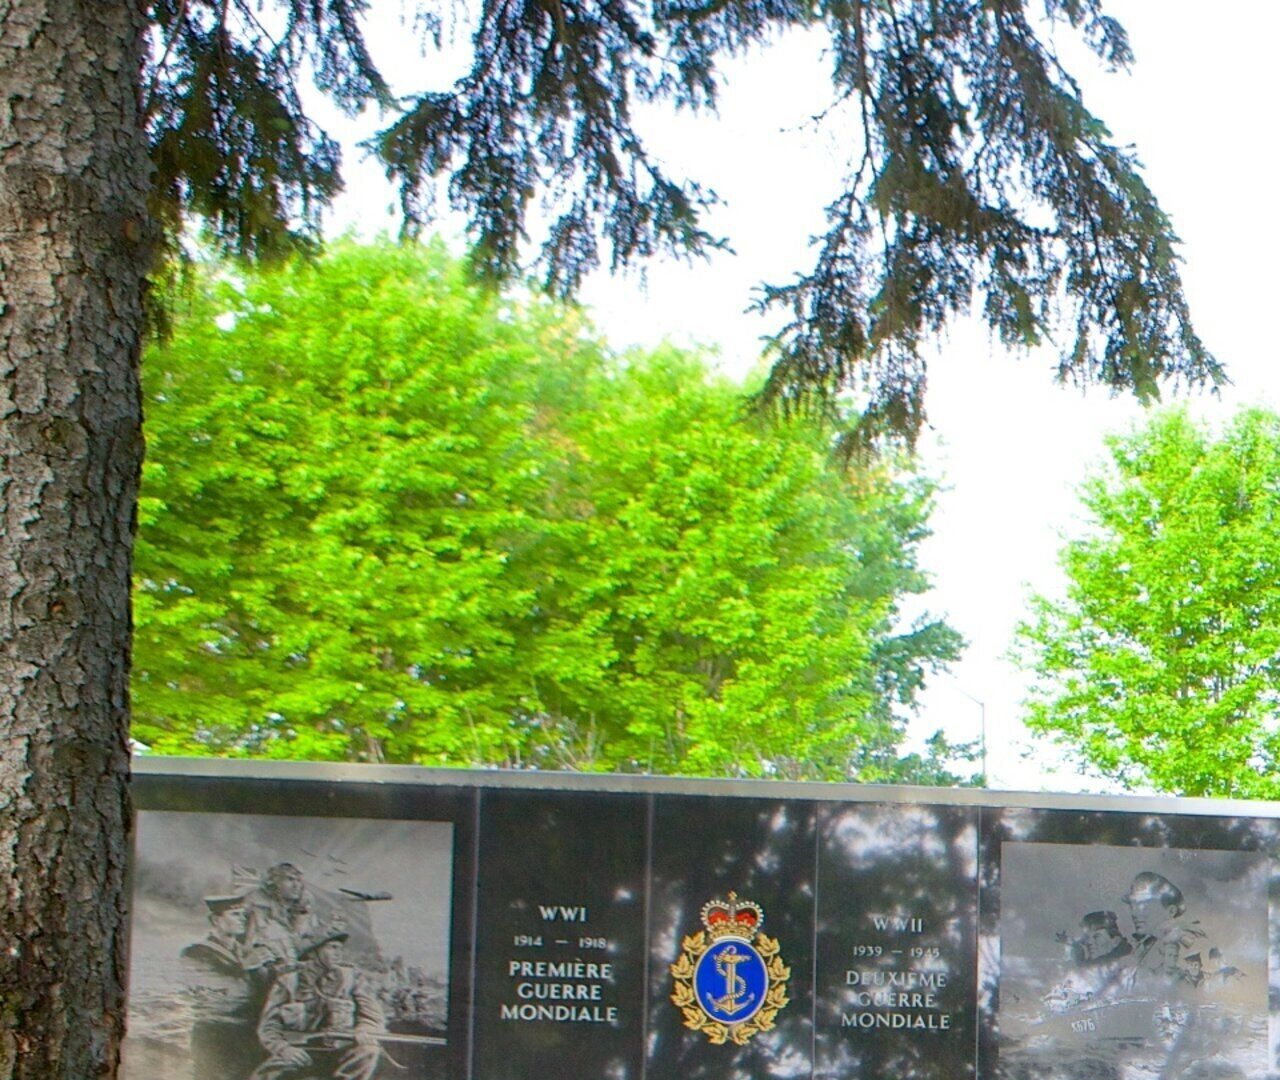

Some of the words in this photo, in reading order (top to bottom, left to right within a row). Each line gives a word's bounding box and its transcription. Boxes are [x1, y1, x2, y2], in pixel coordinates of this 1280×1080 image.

[539, 906, 587, 922] WWI
[873, 917, 923, 933] WWII
[513, 936, 543, 948] 1914
[579, 937, 607, 949] 1918
[853, 946, 883, 957] 1939
[508, 956, 612, 979] PREMIÈRE
[517, 982, 602, 1000] GUERRE
[858, 992, 935, 1008] GUERRE
[501, 1003, 618, 1023] MONDIALE
[841, 1012, 950, 1030] MONDIALE
